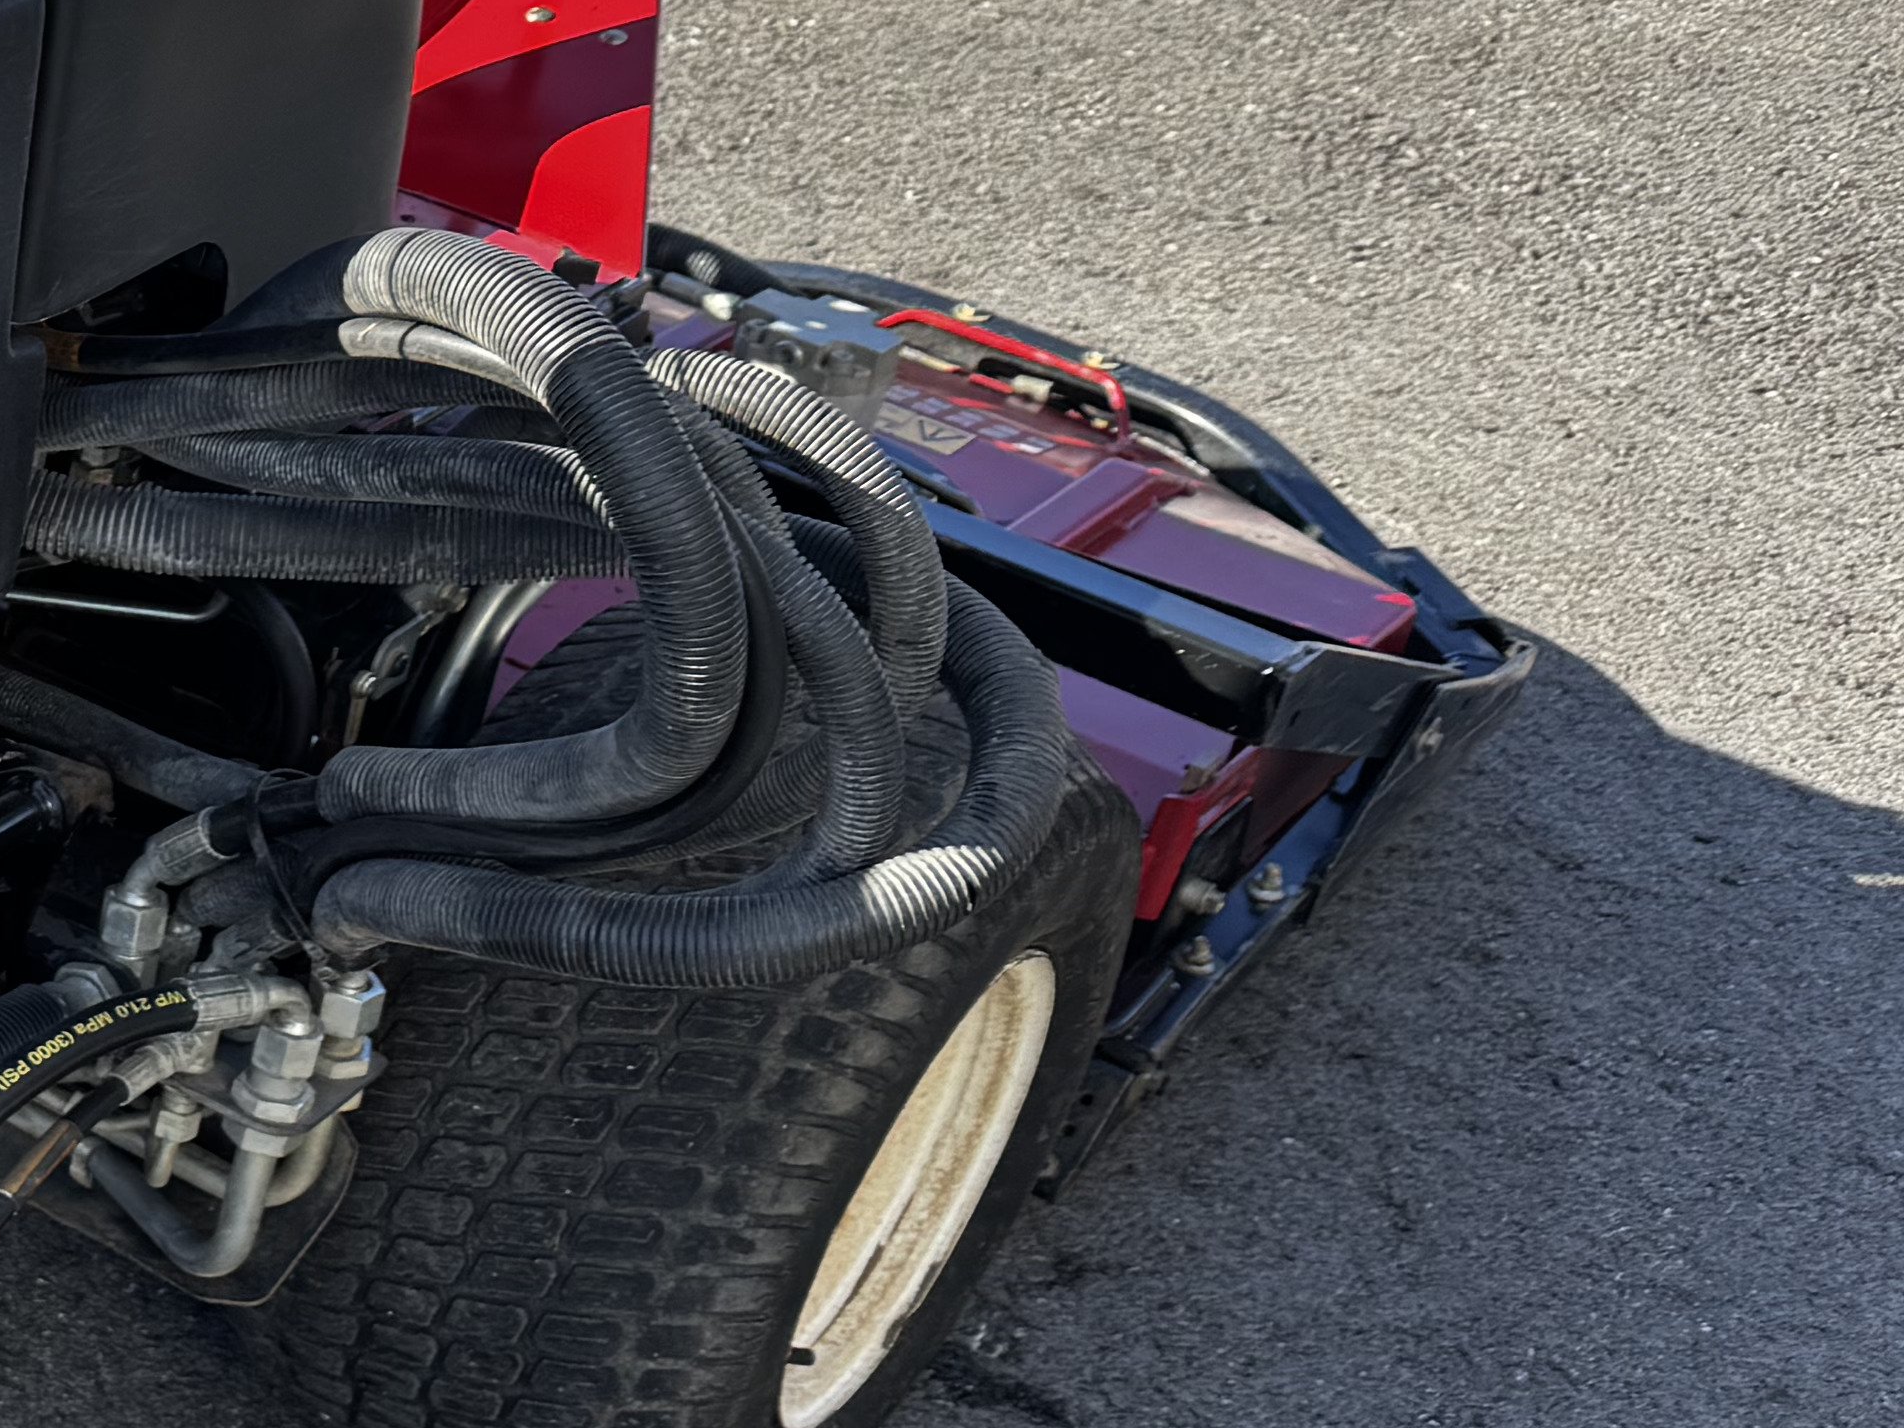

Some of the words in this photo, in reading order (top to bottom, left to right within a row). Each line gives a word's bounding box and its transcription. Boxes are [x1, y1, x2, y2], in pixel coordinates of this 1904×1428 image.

[114, 997, 153, 1018] 21.0
[154, 990, 189, 1009] WP
[73, 1010, 115, 1036] MPa
[27, 1031, 75, 1066] (3000
